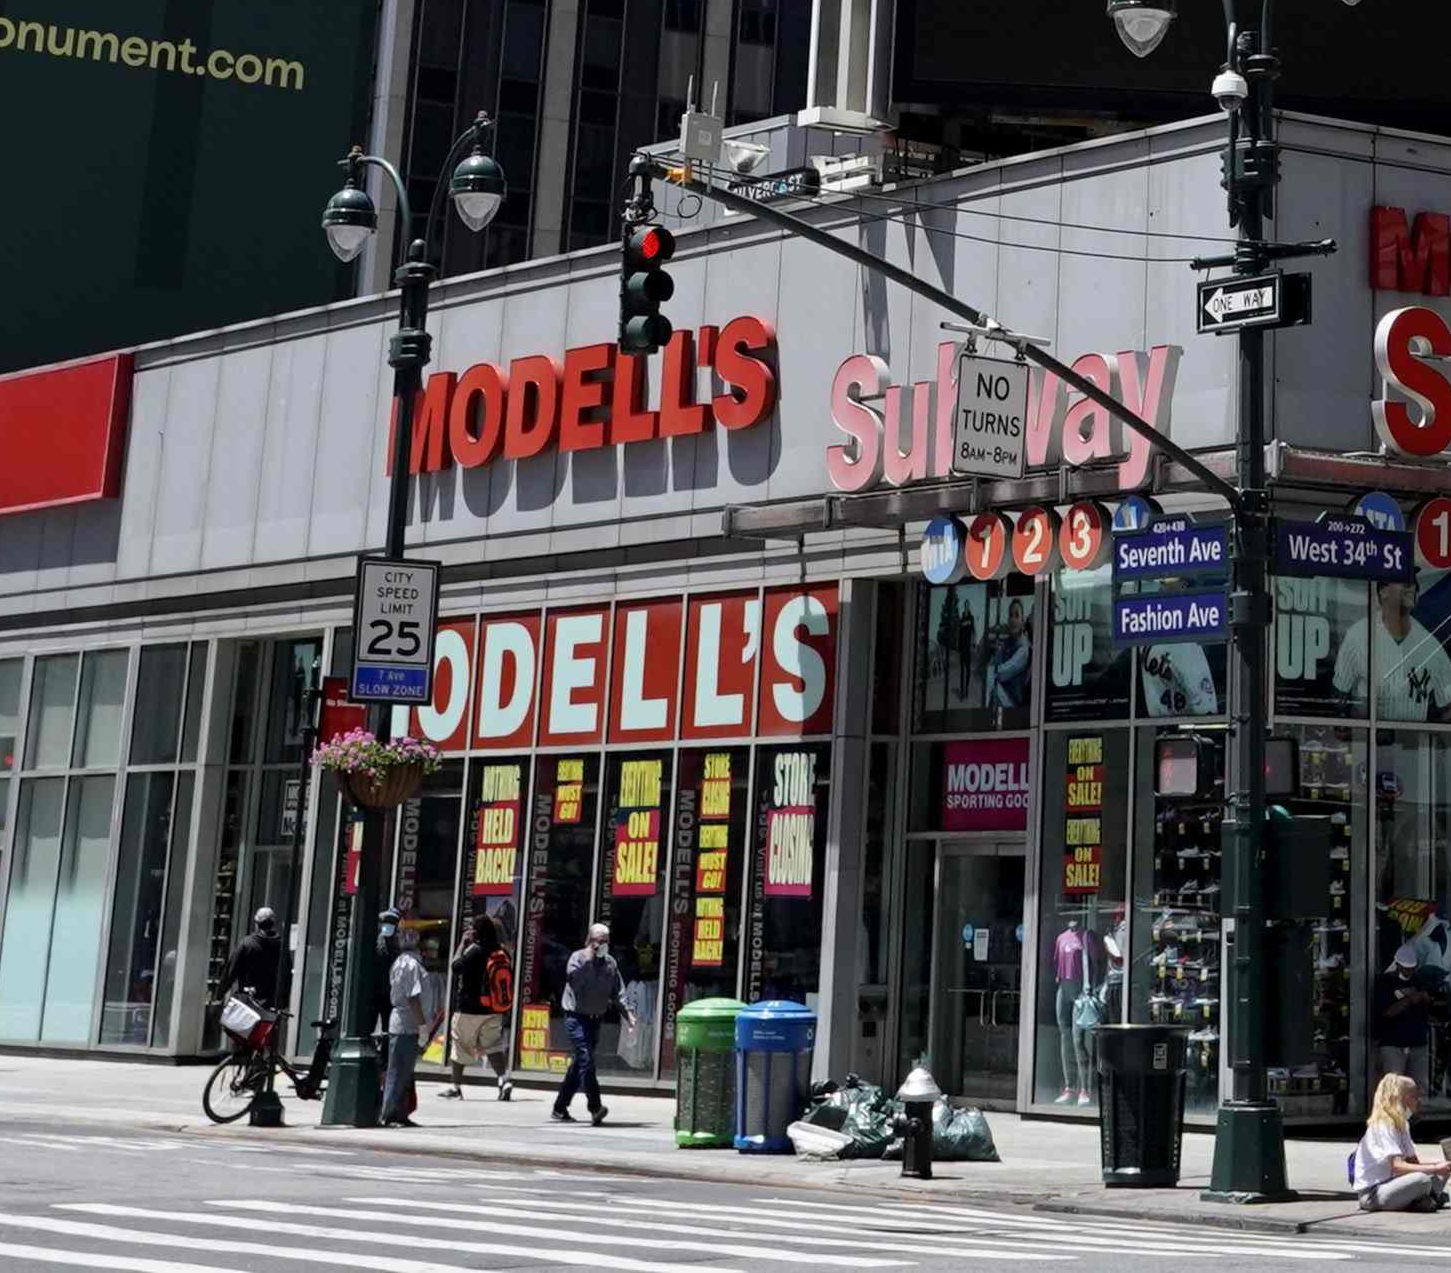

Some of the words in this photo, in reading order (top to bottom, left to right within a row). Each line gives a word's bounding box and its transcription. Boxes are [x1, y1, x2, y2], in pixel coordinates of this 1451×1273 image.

[1213, 295, 1233, 313] ONE
[1243, 289, 1267, 308] WAY
[976, 372, 1010, 402] NO
[962, 409, 1020, 438] TURNS
[975, 524, 991, 569] 1
[1023, 517, 1043, 564] 2
[1069, 509, 1092, 560] 3
[1432, 510, 1449, 558] 1
[1119, 540, 1185, 570] Seventh
[1189, 536, 1221, 562] Ave
[1288, 534, 1338, 564] West
[1343, 540, 1378, 567] 34th
[1383, 544, 1402, 570] St
[376, 586, 419, 600] SPEED
[384, 571, 414, 583] CITY
[380, 602, 414, 615] LIMIT
[1122, 604, 1183, 634] Fashion
[1187, 602, 1220, 628] Ave
[367, 619, 421, 657] 25
[1277, 613, 1331, 681] UP
[391, 595, 830, 744] ODELL'S
[1052, 622, 1094, 688] UP
[358, 683, 389, 695] SLOW
[392, 683, 423, 696] ZONE
[773, 752, 817, 806] STORE
[1076, 765, 1094, 781] ON
[946, 793, 1003, 809] SPORTING
[1067, 781, 1102, 807] SALE!
[482, 807, 515, 845] HELD
[627, 810, 651, 839] ON
[474, 846, 518, 885] BACK!
[529, 793, 552, 913] MODELL'S
[614, 840, 659, 885] SALE!
[673, 789, 695, 915] MODELL'S
[1074, 846, 1092, 862] ON
[1065, 863, 1100, 888] SALE!
